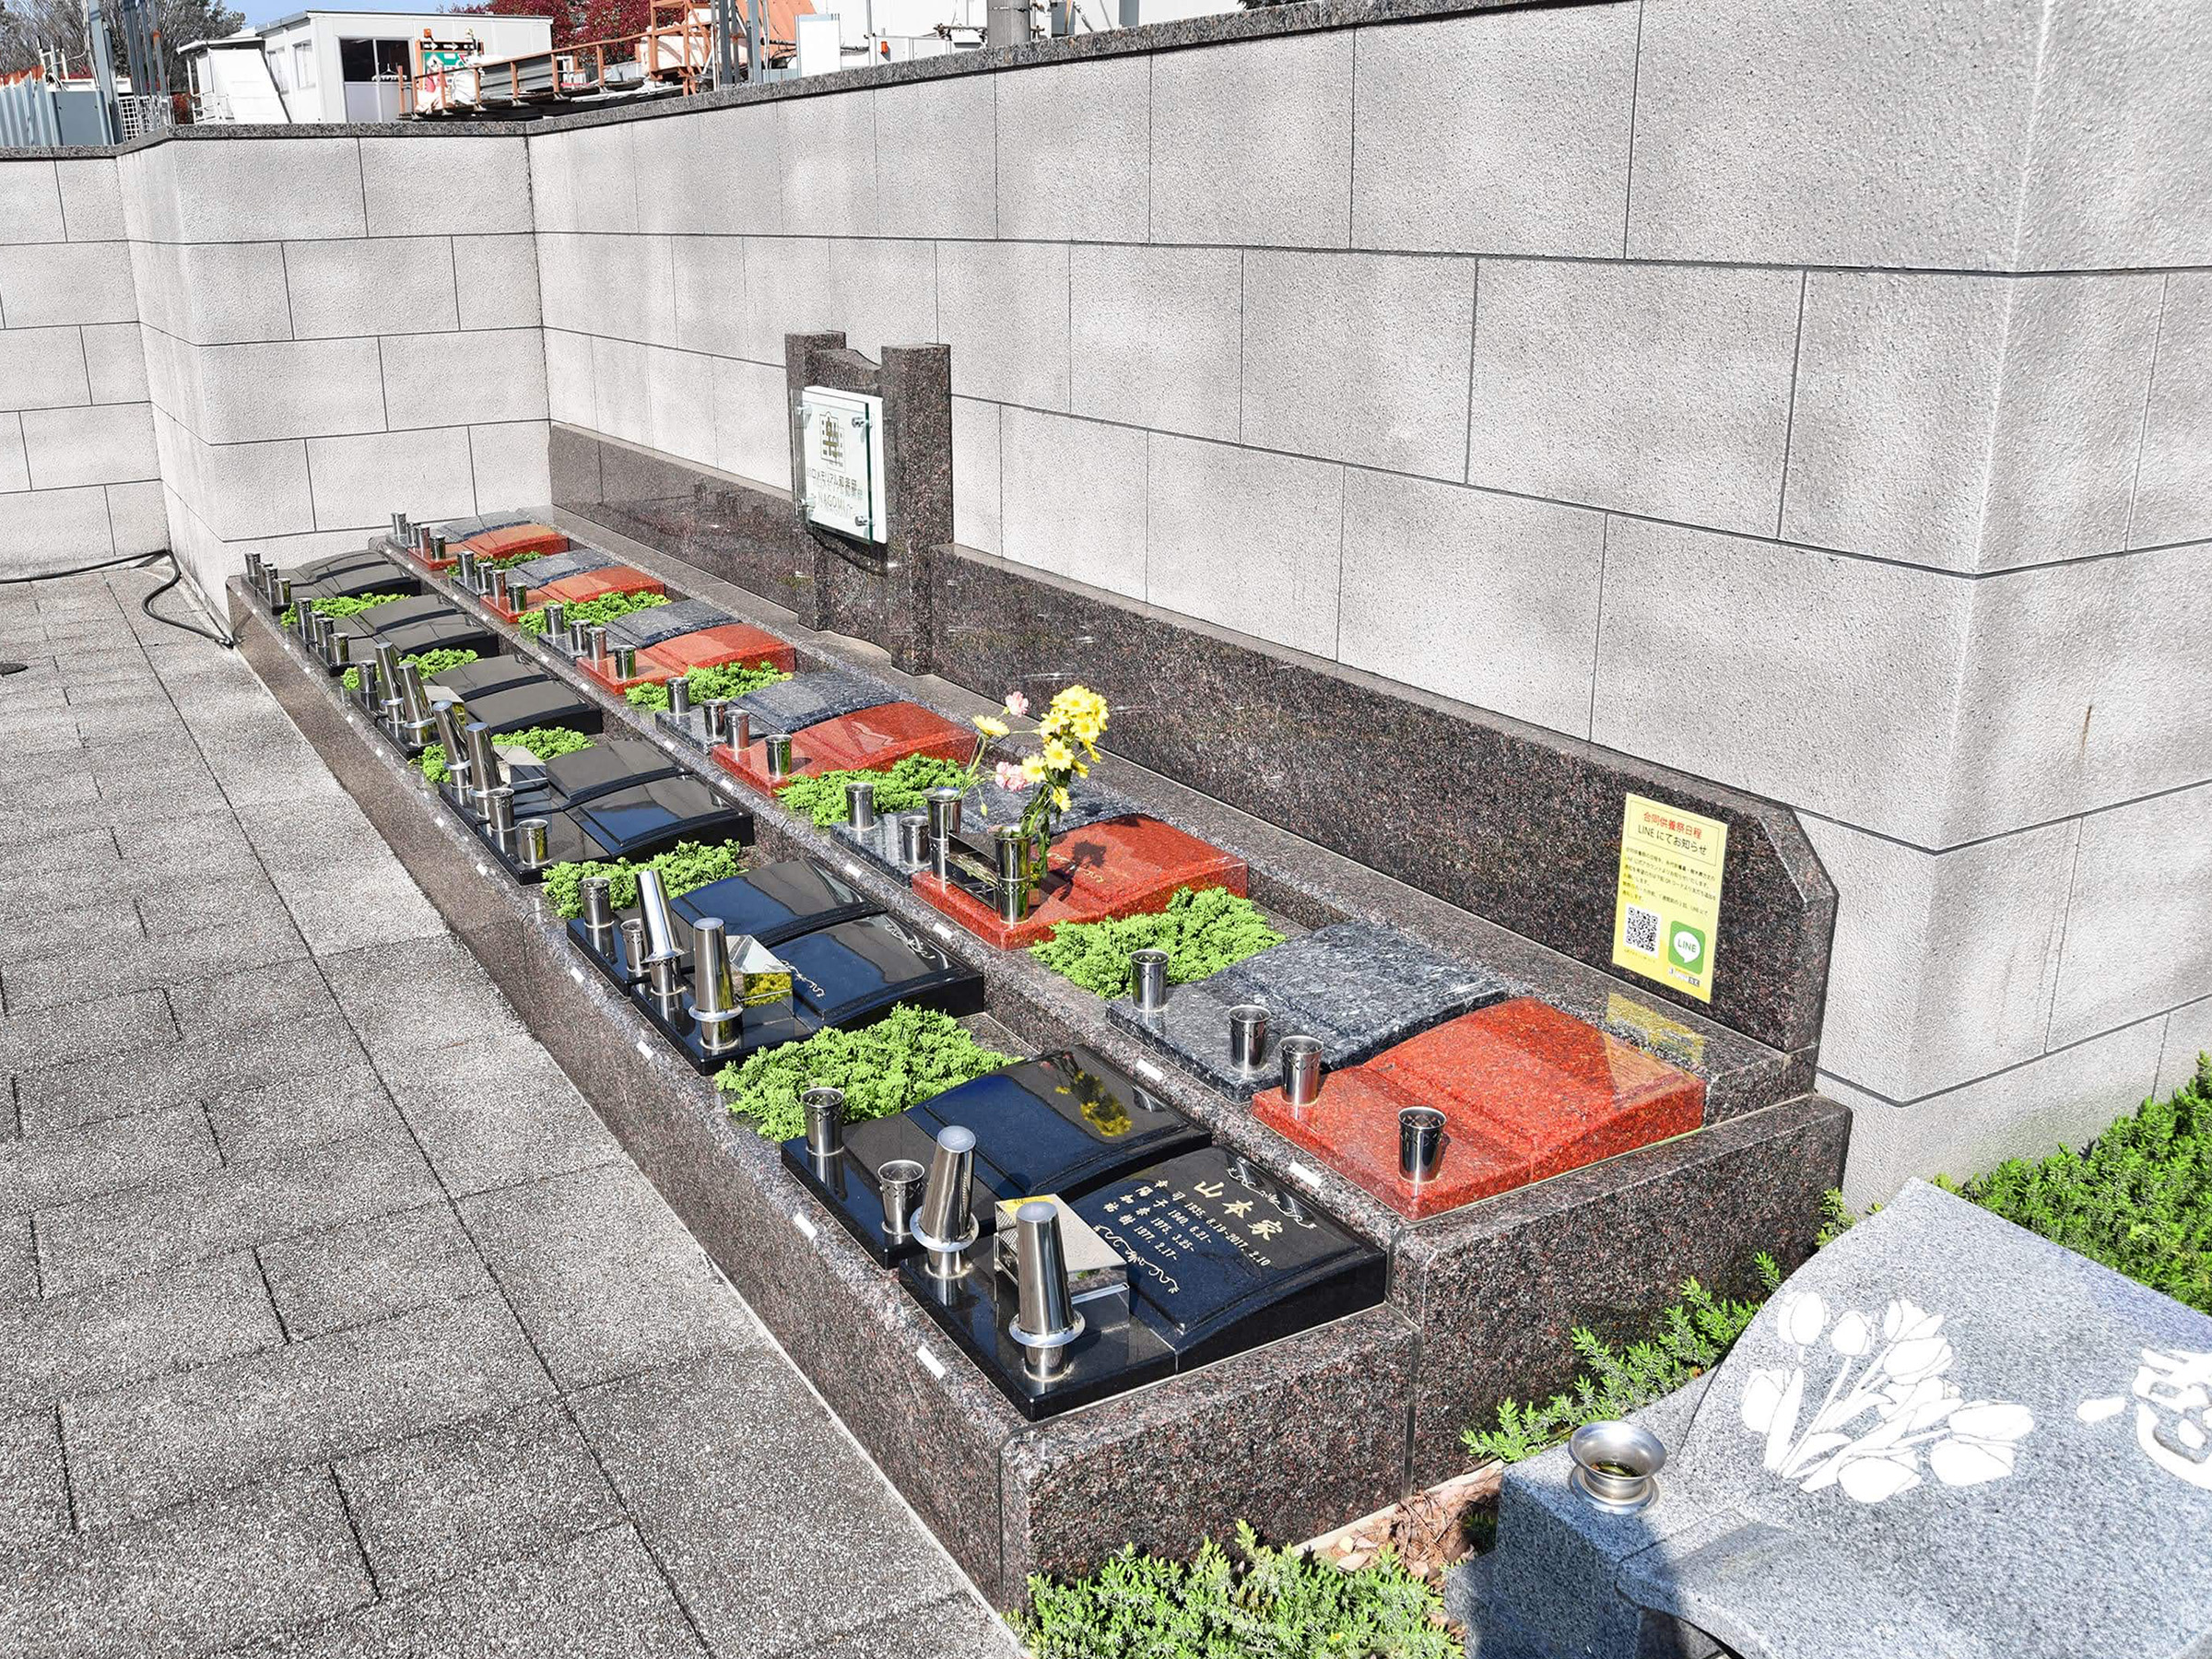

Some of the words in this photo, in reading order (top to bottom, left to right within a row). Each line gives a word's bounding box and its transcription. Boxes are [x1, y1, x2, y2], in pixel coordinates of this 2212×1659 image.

[1644, 812, 1702, 839] 合同供養祭日程
[1638, 824, 1655, 838] LINE
[1656, 830, 1707, 855] にてお知らせ
[1677, 940, 1697, 953] LINE
[1135, 1185, 1169, 1207] 陽子
[1194, 1181, 1283, 1241] 山本家
[1248, 1251, 1271, 1266] 2.10
